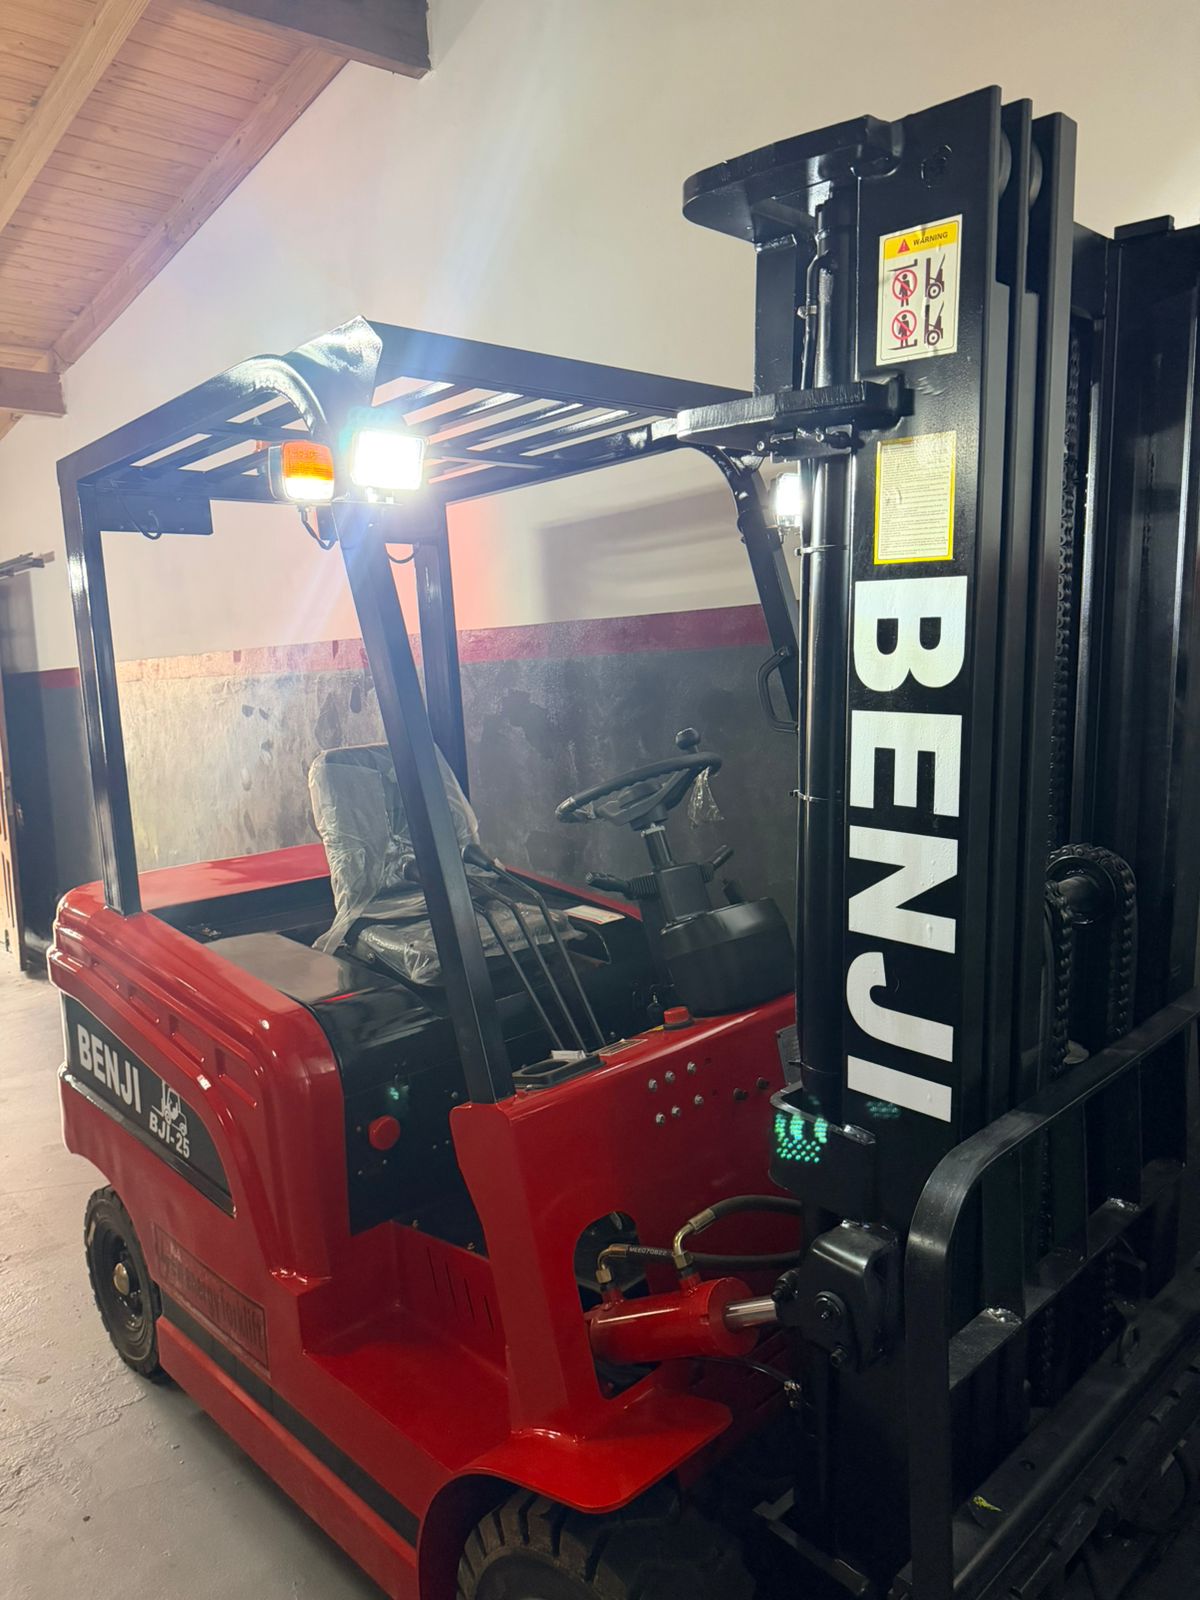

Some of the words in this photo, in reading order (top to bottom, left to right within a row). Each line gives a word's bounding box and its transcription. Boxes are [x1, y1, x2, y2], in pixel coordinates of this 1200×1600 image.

[913, 231, 948, 246] WARNING
[846, 576, 968, 1123] BENJI
[77, 1023, 142, 1114] BENJI
[149, 1111, 191, 1159] BJI-25
